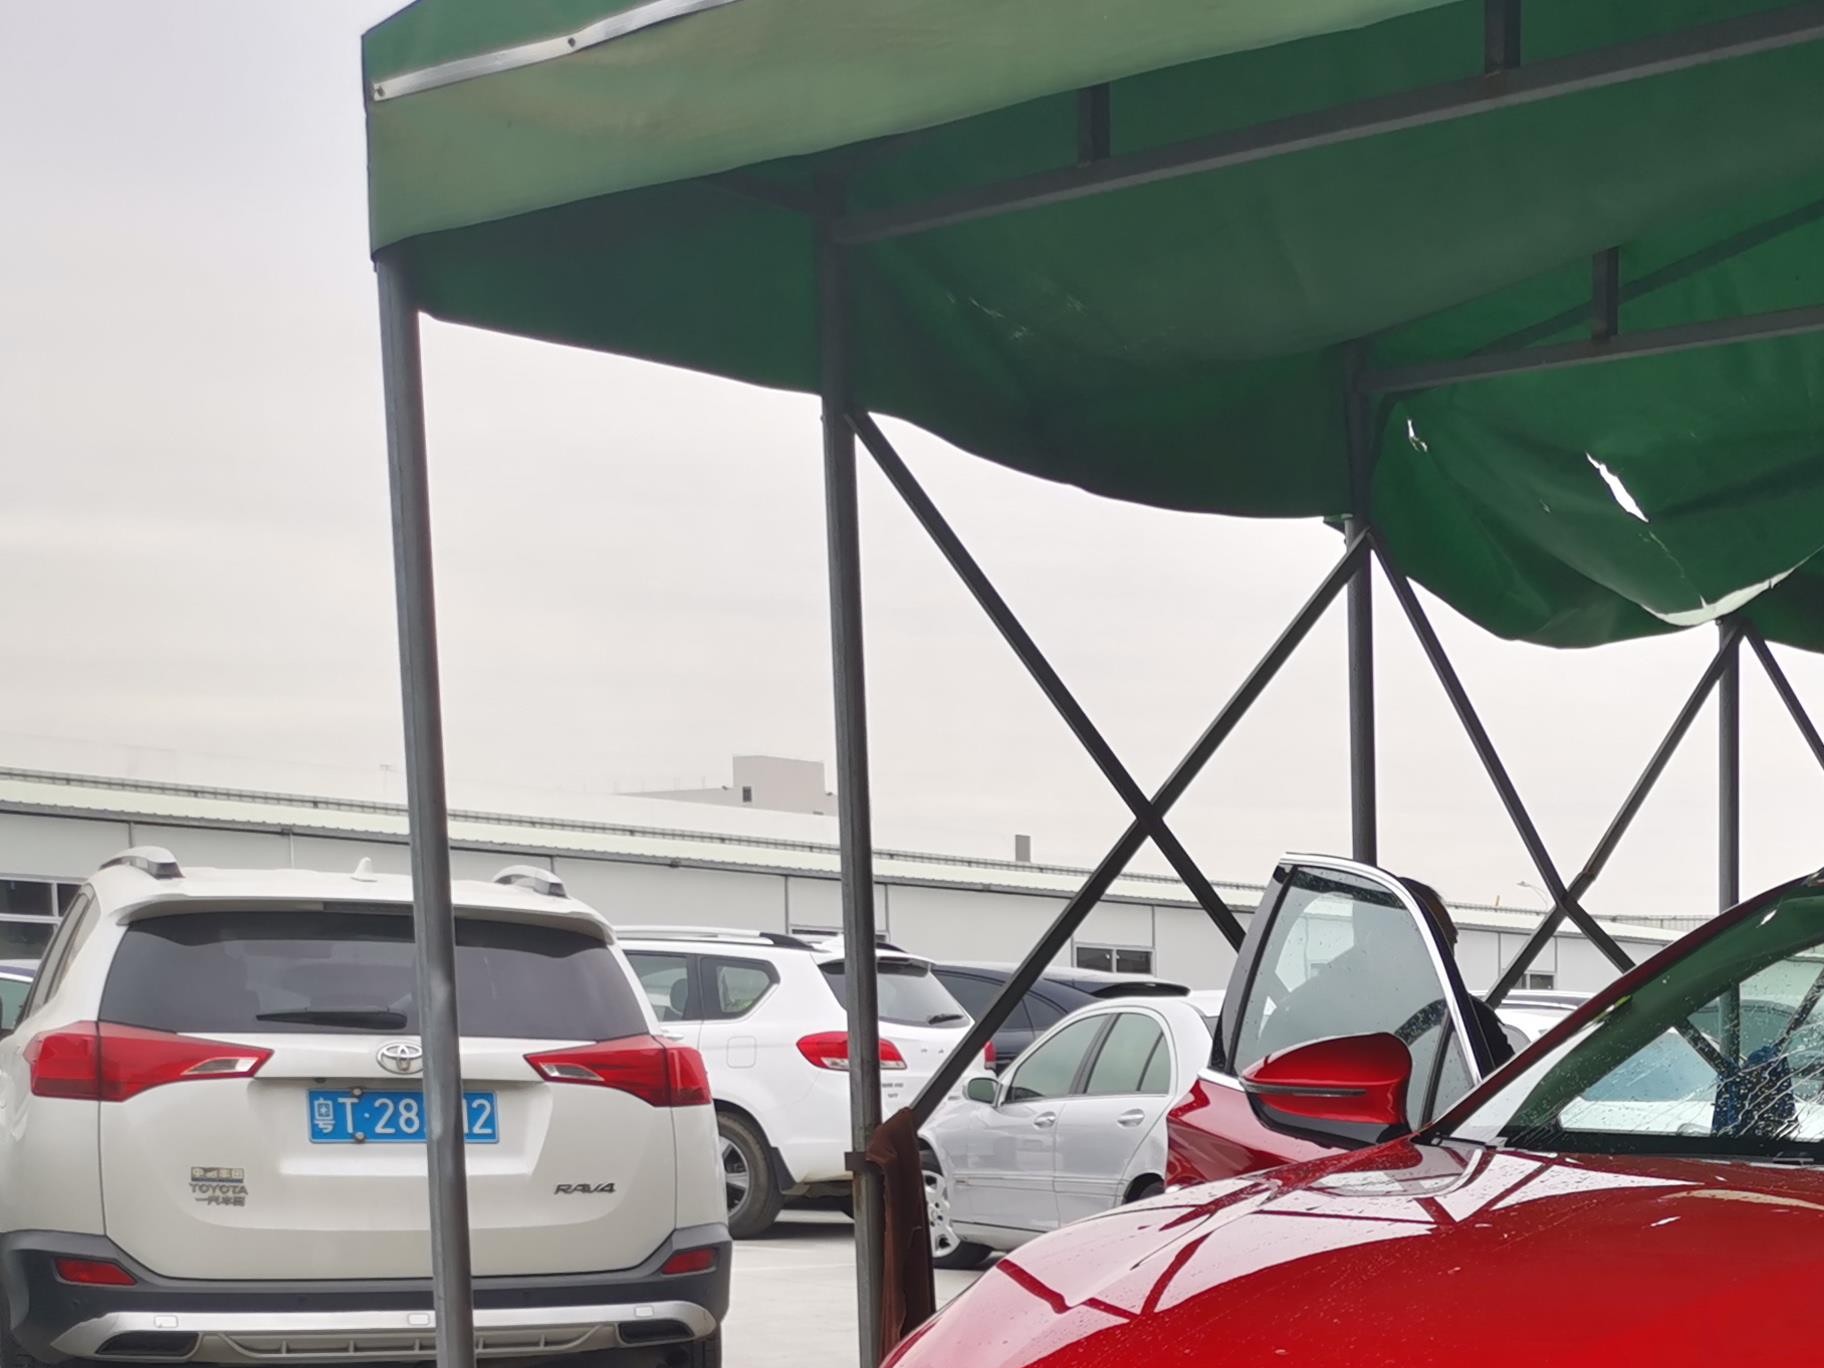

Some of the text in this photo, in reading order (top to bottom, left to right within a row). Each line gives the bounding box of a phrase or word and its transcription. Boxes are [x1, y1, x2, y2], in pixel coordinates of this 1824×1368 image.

[313, 1097, 494, 1134] 粤T·282
[188, 1183, 248, 1195] TOYOTA
[553, 1183, 616, 1196] RAV4
